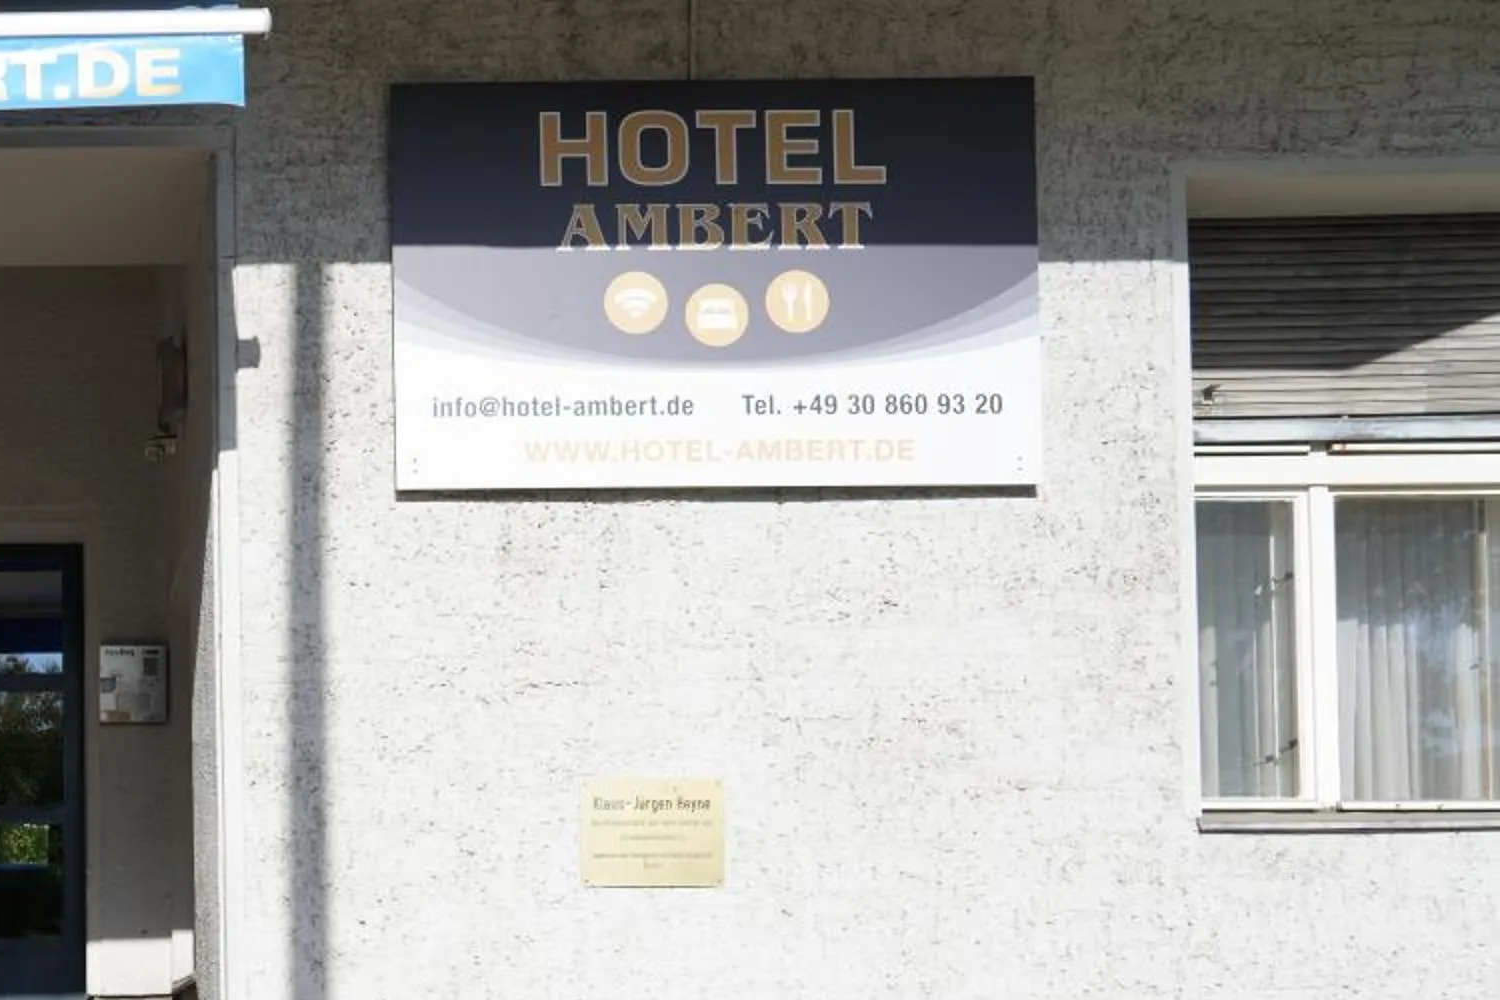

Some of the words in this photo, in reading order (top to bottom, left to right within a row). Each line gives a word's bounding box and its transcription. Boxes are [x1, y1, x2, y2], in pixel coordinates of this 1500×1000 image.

[538, 108, 888, 188] HOTEL
[554, 201, 874, 252] AMBERT
[431, 394, 695, 418] info@hotel-ambert.de
[741, 393, 783, 416] Tel.
[792, 393, 839, 416] +49
[847, 393, 876, 416] 30
[884, 393, 929, 416] 860
[935, 393, 967, 416] 93
[974, 392, 1004, 415] 20
[522, 437, 917, 465] WWW.HOTEL-AMBERT.DE
